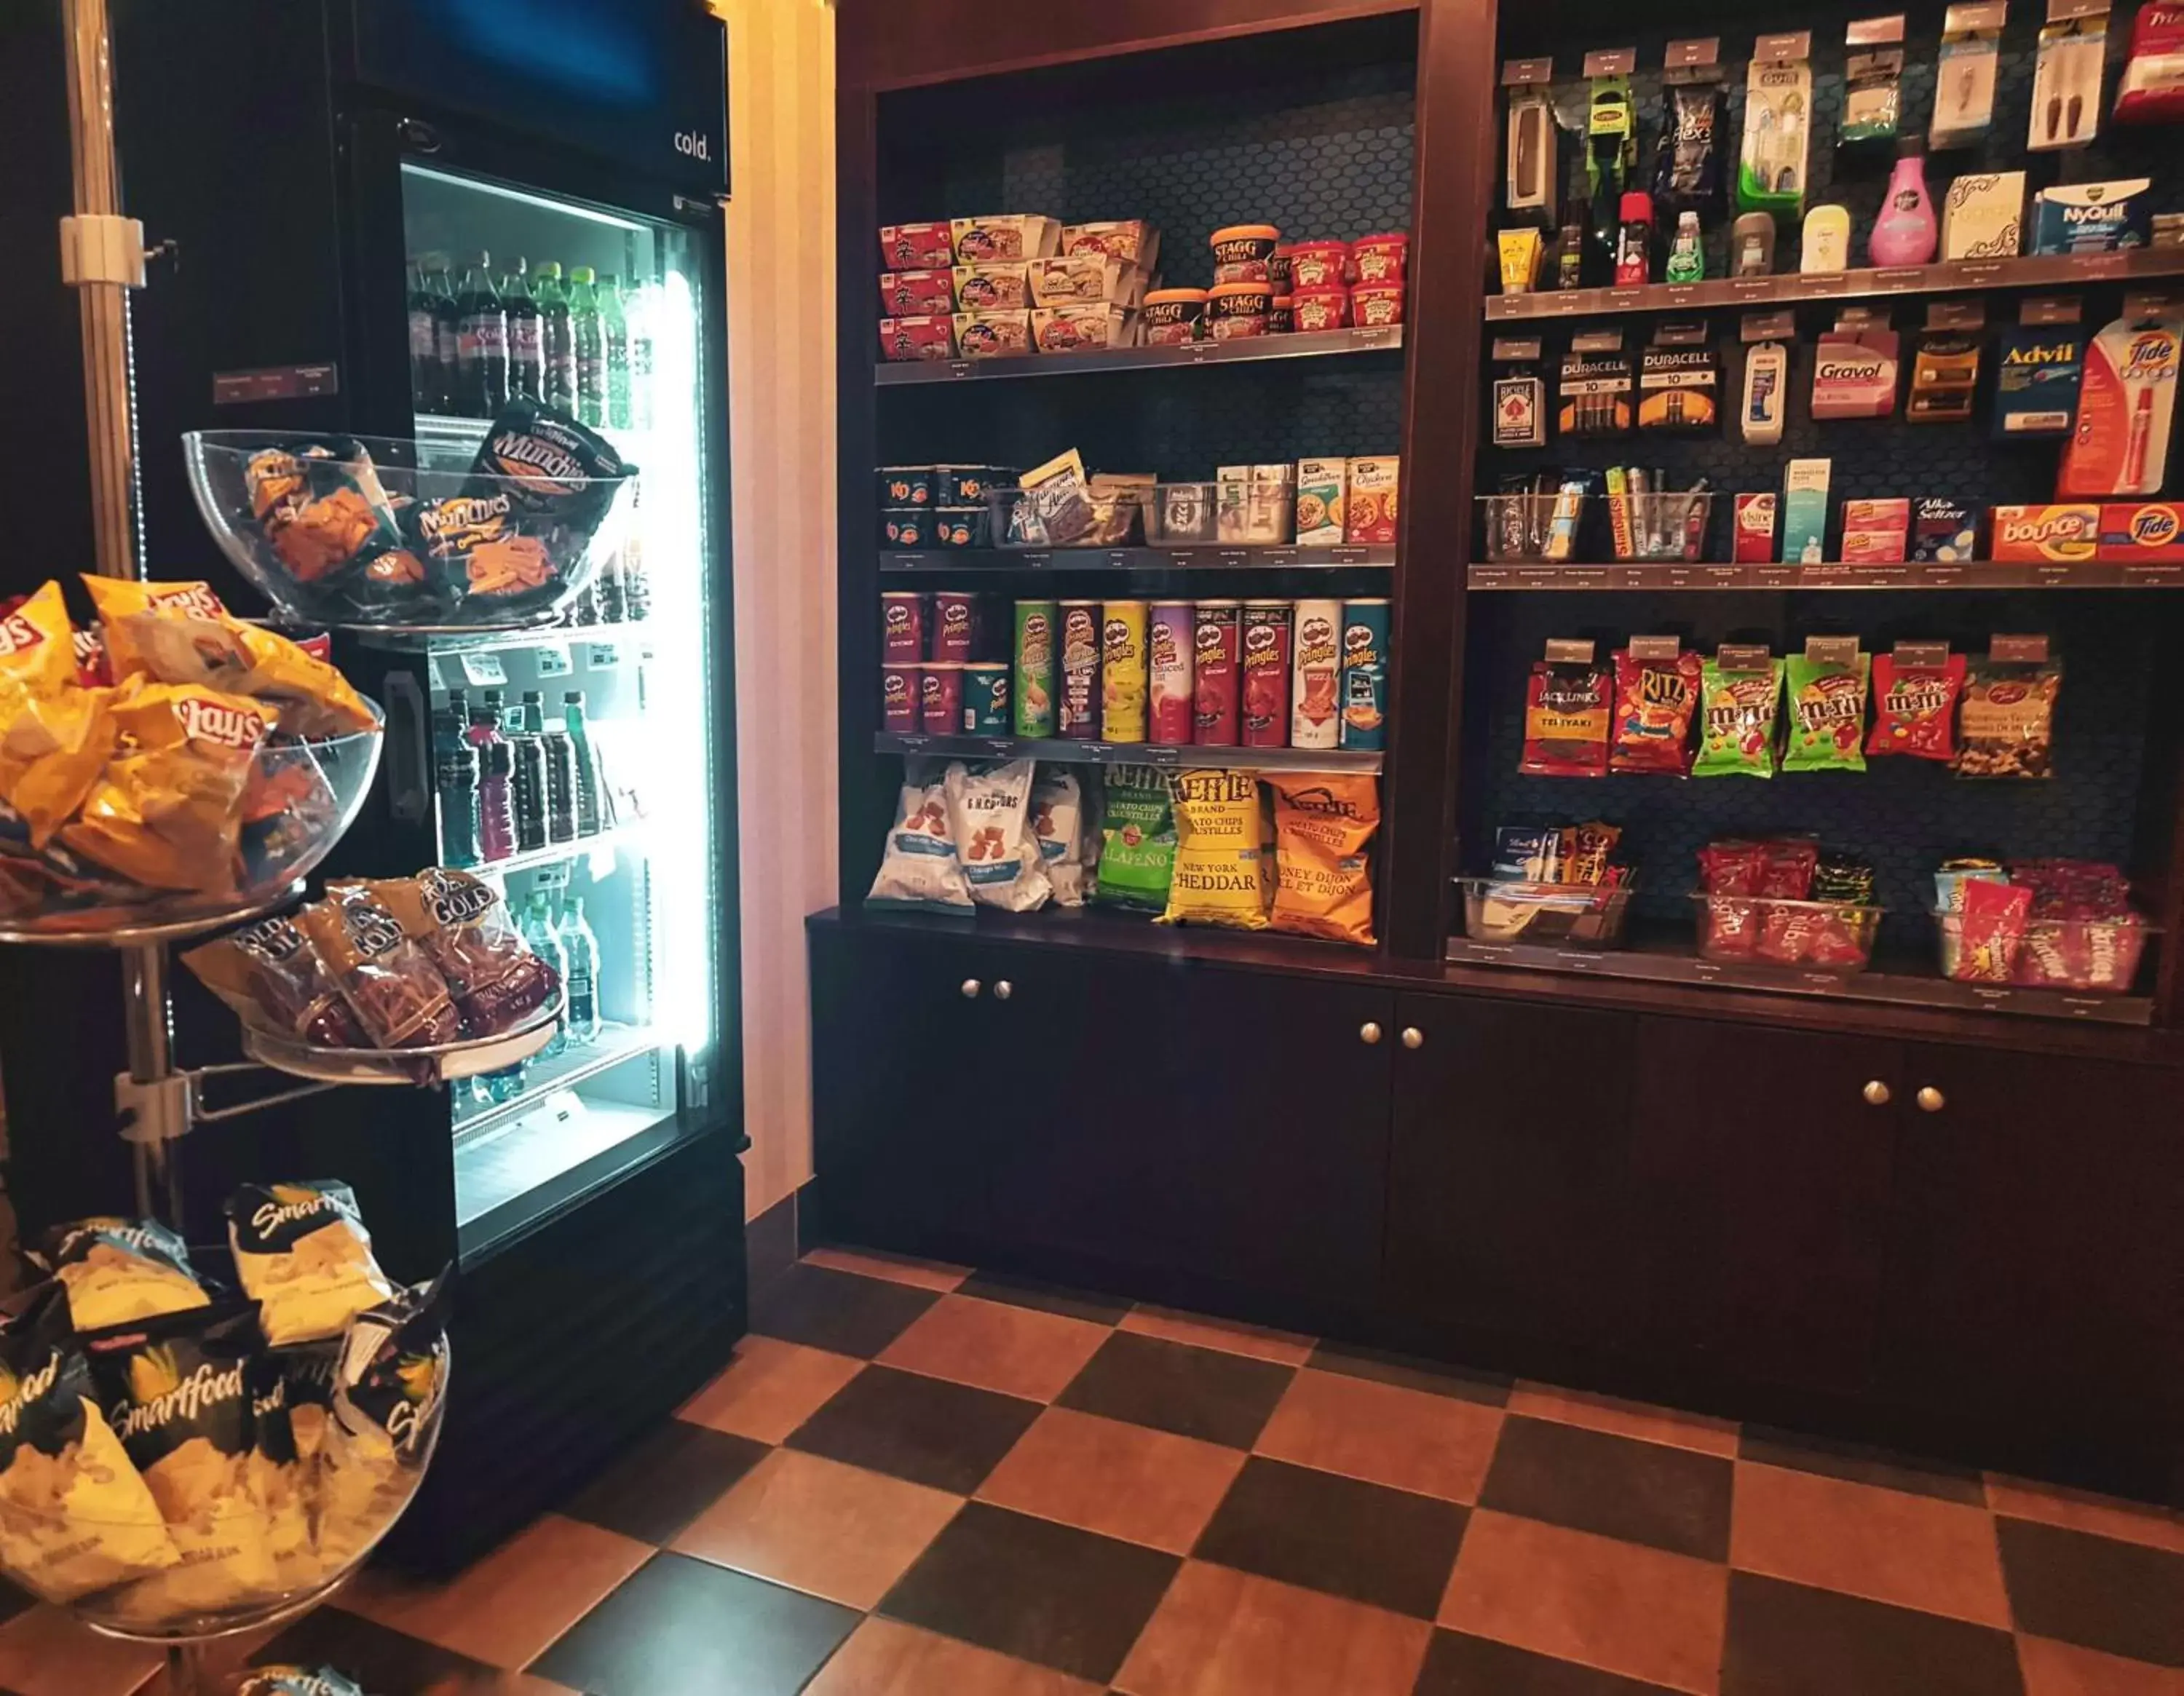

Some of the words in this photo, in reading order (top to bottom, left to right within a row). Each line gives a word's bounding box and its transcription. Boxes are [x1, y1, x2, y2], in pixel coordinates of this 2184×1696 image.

[674, 131, 711, 162] cold.
[2063, 203, 2125, 225] NyQuil
[1215, 241, 1257, 258] STAGG
[1146, 304, 1182, 320] STAGG
[1219, 295, 1264, 313] STAGG
[1644, 352, 1711, 367] DURACELL
[2004, 343, 2073, 364] Advil
[2130, 340, 2174, 365] Tide
[1562, 360, 1627, 376] DURACELL
[1667, 373, 1680, 384] 10
[1820, 363, 1883, 381] Gravol
[1586, 381, 1598, 392] 10
[493, 431, 587, 492] Munchies
[420, 494, 510, 537] Munchies
[2003, 515, 2082, 542] bounce
[2135, 515, 2175, 538] Tide
[1246, 648, 1280, 673] Pringles
[1298, 644, 1337, 671] Pringles
[1642, 669, 1686, 703] RITZ
[1214, 817, 1243, 826] CHIPS
[1183, 863, 1204, 872] NEW
[1207, 863, 1238, 873] YORK
[1315, 870, 1352, 884] DIJON
[1296, 880, 1314, 892] ET
[1316, 883, 1356, 896] DIJON
[434, 885, 494, 925] GOLD
[354, 916, 403, 957] GOLD
[109, 1357, 245, 1443] Smartfood
